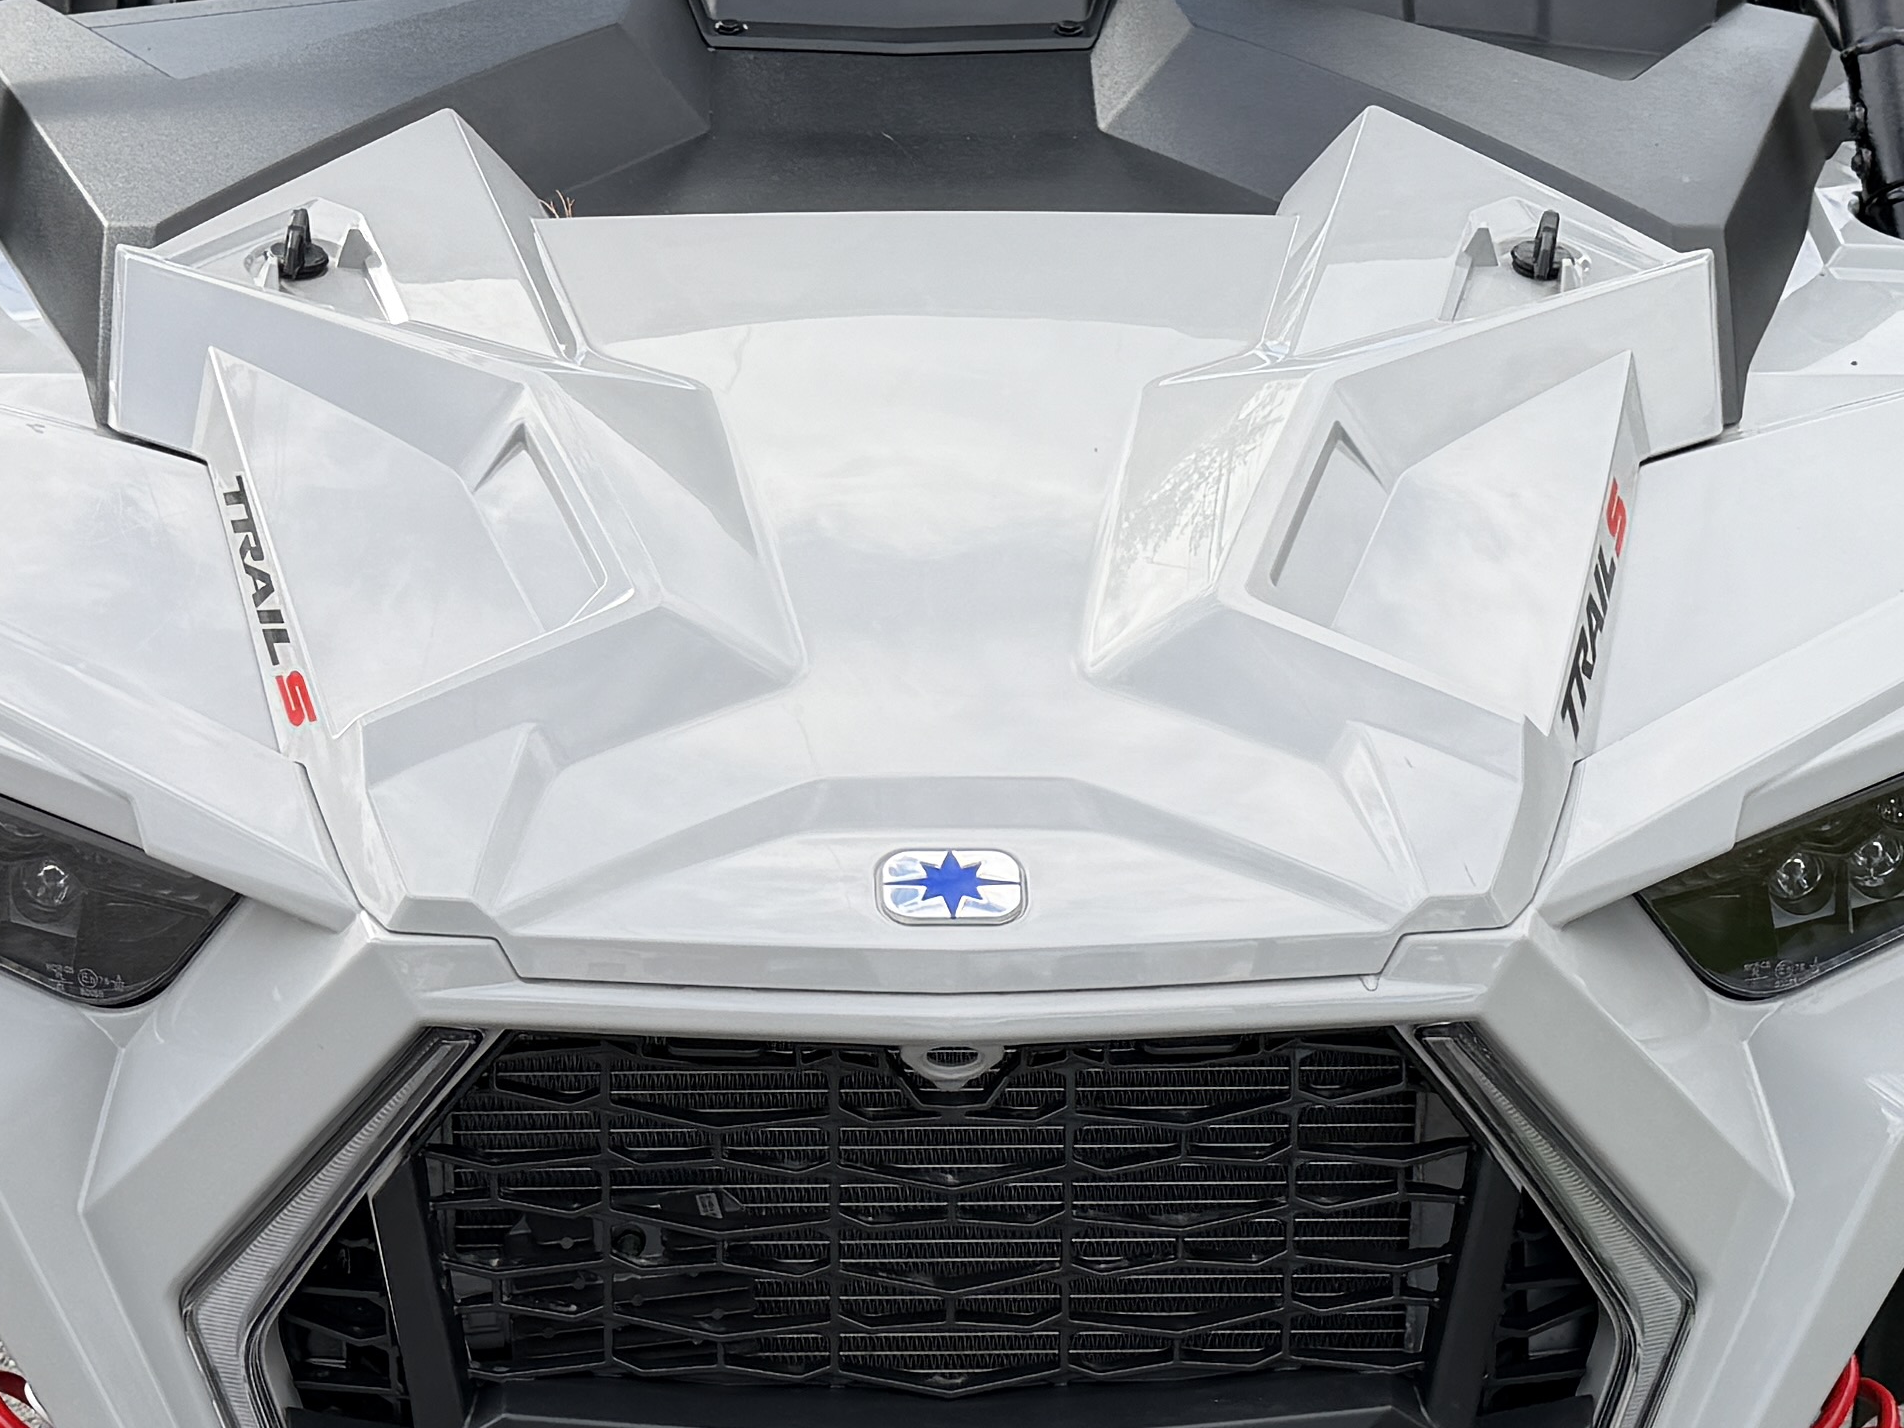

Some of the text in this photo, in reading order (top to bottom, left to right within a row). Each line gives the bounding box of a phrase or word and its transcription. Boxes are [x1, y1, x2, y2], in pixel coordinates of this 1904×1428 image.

[223, 475, 317, 727] TRAIL S
[1560, 476, 1628, 743] TRAIL S
